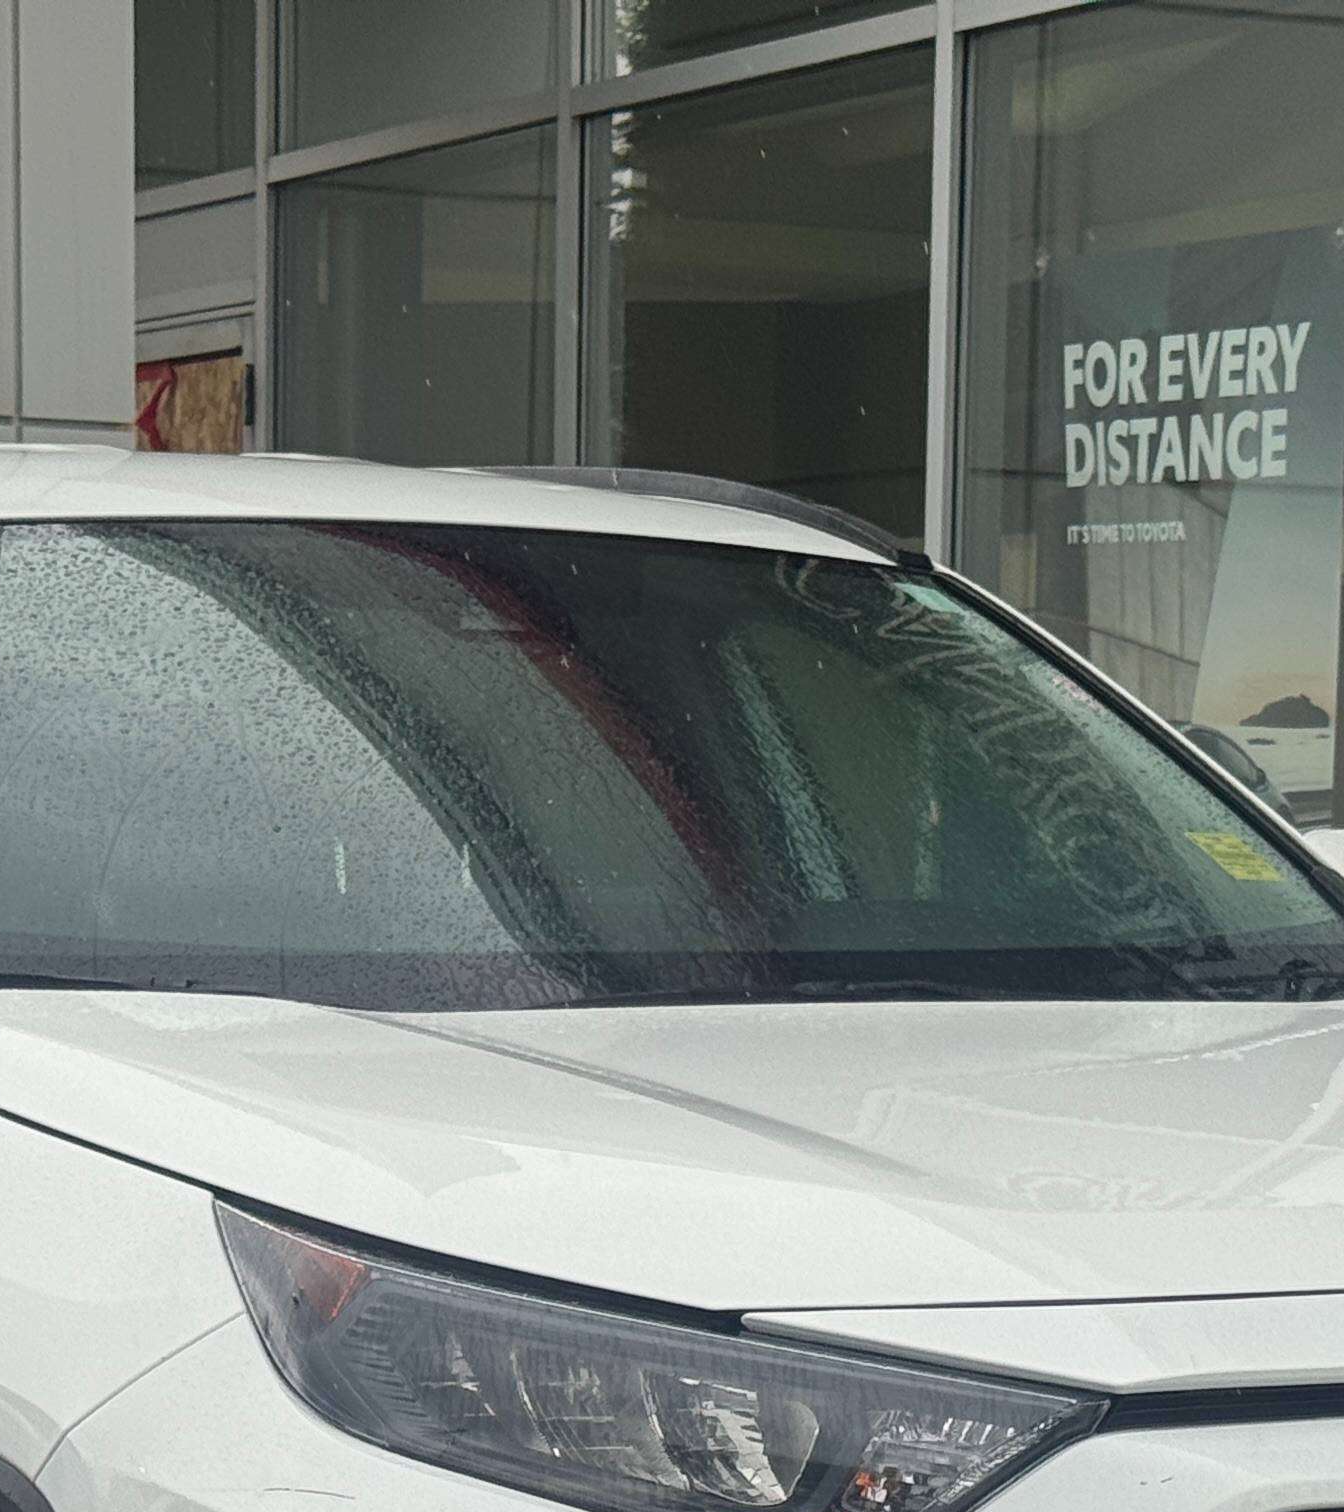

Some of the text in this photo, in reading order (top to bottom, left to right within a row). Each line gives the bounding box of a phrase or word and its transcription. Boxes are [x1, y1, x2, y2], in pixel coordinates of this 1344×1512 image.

[1063, 322, 1311, 409] FOR EVERY
[1065, 408, 1288, 489] DISTANCE
[1067, 520, 1186, 545] IT'S TIME TO TOYOTA
